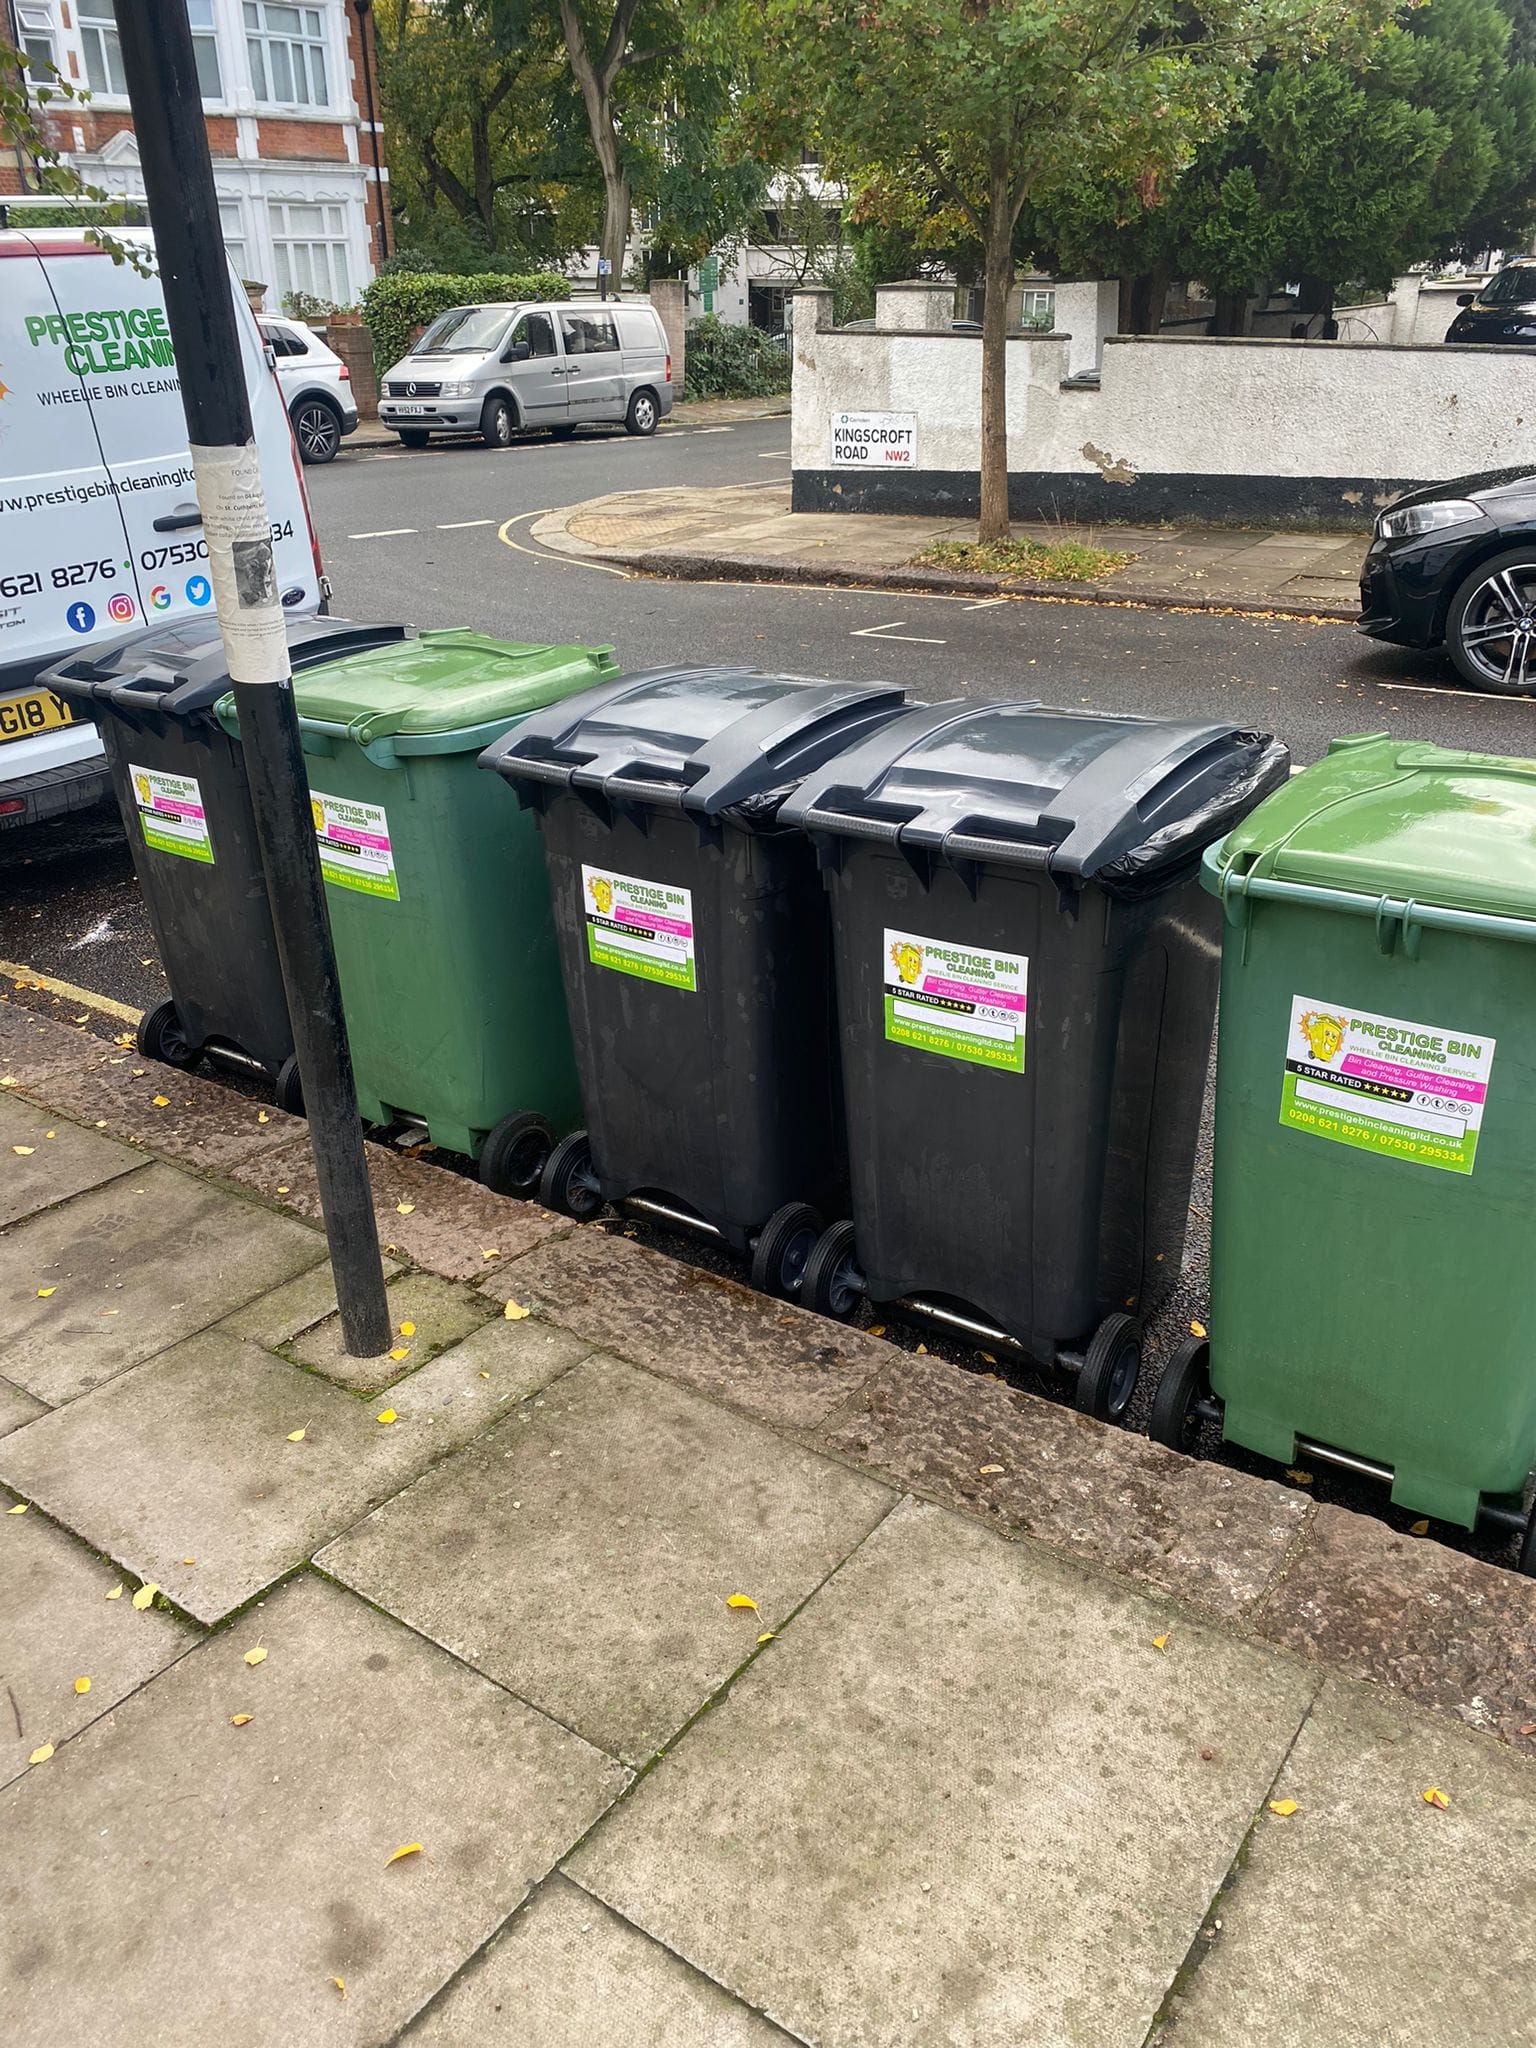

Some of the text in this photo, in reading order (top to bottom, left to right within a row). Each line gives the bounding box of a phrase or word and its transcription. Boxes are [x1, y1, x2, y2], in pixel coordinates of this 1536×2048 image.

[24, 308, 169, 346] PRESTIGE
[64, 338, 175, 376] CLEANIN
[37, 378, 182, 406] WHEELIE BIN CLEANIN
[834, 428, 912, 444] KINGSCROFT
[835, 445, 910, 462] ROAD NW2
[0, 468, 197, 511] w.prestigebincleaninglt
[0, 572, 43, 598] 621
[51, 559, 116, 589] 8276
[141, 540, 209, 570] 07530
[0, 699, 45, 734] G18
[323, 799, 382, 822] PRESTIGE BIN
[613, 879, 685, 906] PRESTIGE BIN
[630, 895, 668, 910] CLEANING
[596, 917, 609, 927] STAR
[610, 921, 628, 932] RATED
[925, 945, 1019, 975] PRESTIGE BIN
[946, 963, 996, 980] CLEANING
[897, 988, 915, 999] STAR
[916, 993, 939, 1005] RATED
[927, 976, 938, 985] Bin
[969, 986, 989, 996] Gutter
[989, 990, 1018, 1003] Cleaning
[952, 973, 962, 981] BIN
[962, 975, 992, 987] CLEANING
[992, 981, 1018, 991] SERVICE
[937, 987, 1007, 1008] and Pressure Washing
[891, 1026, 910, 1037] 0208
[912, 1031, 927, 1042] 621
[956, 1042, 983, 1056] 07530
[985, 1049, 1018, 1064] 295334
[894, 1018, 1015, 1052] www.prestigebincleaningltd.co.uk
[1349, 1018, 1482, 1060] PRESTIGE BIN
[1349, 1045, 1478, 1079] WHEELIE BIN CLEANING SERVICE
[1378, 1040, 1447, 1064] CLEANING
[1297, 1064, 1362, 1089] 5 STAR RATED
[1347, 1055, 1362, 1065] Bin
[1405, 1069, 1434, 1083] Gutter
[1435, 1075, 1475, 1092] Cleaning
[1361, 1068, 1458, 1098] and Pressure Washing
[1289, 1109, 1315, 1125] 0208
[1318, 1119, 1338, 1131] 621
[1341, 1125, 1370, 1141] 8276
[1379, 1135, 1416, 1152] 07530
[1419, 1144, 1465, 1163] 295334
[1294, 1100, 1463, 1149] www.prestigebincleaningltd.co.uk
